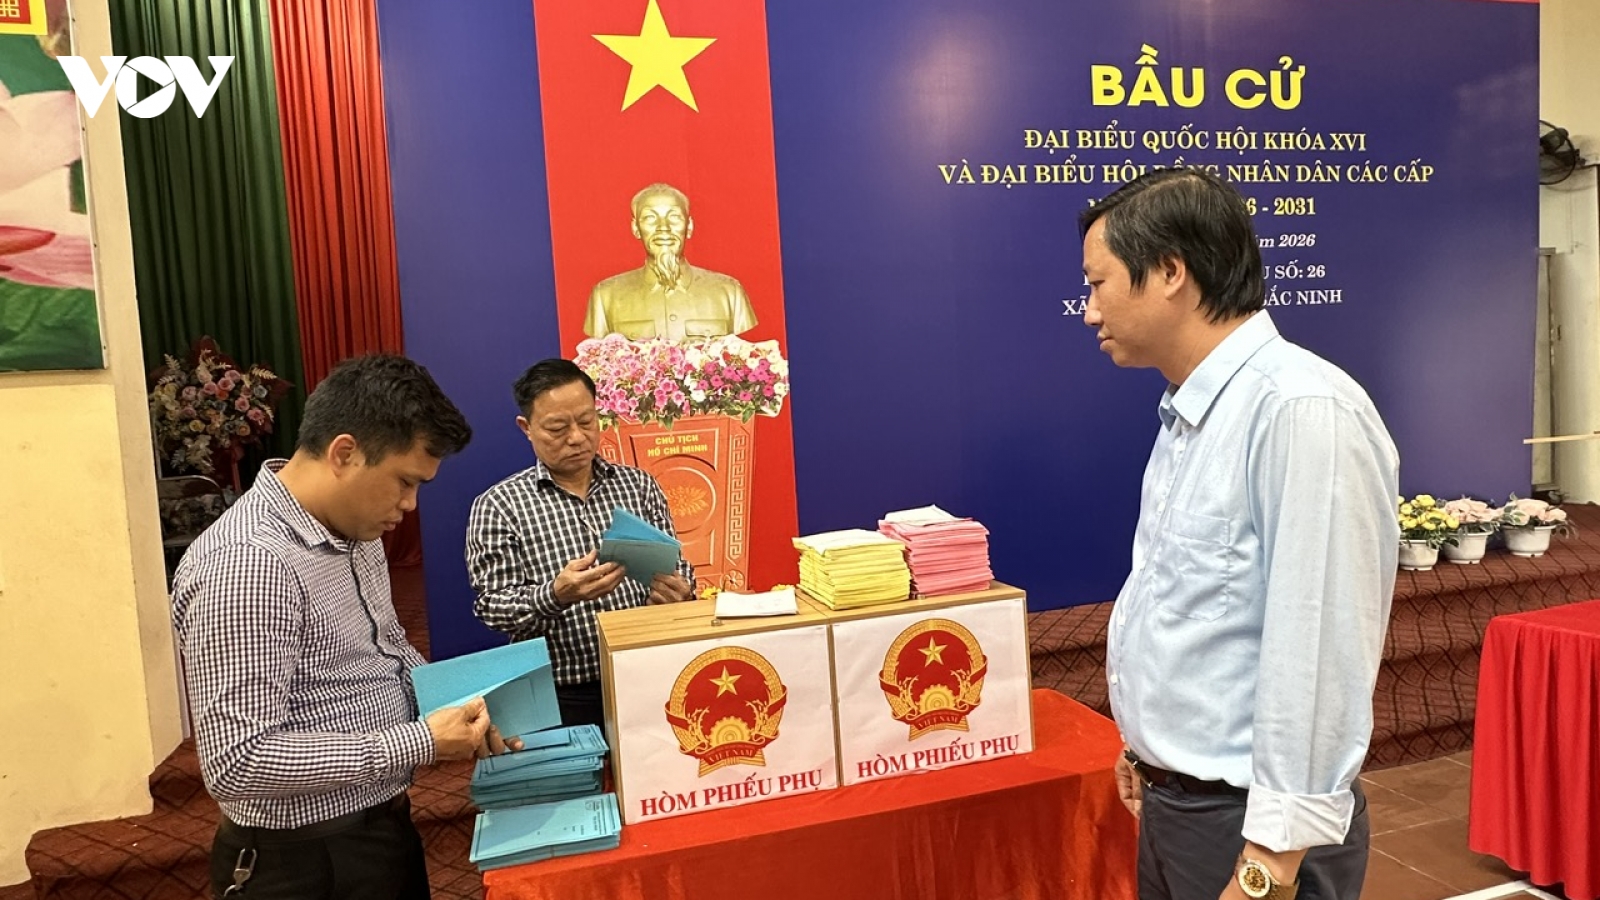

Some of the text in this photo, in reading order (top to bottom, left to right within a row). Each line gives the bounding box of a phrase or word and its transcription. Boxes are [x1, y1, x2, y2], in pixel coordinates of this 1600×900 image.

[1091, 43, 1306, 110] BẦU CỬ
[1024, 119, 1367, 155] ĐẠI BIỂU QUỐC HỘI KHÓA XVI
[938, 158, 975, 184] VÀ
[980, 164, 1027, 189] ĐẠI
[1034, 154, 1095, 184] BIỂU
[1226, 159, 1290, 183] NHÂN
[1296, 159, 1341, 183] DÂN
[1346, 159, 1388, 183] CÁC
[1393, 158, 1434, 183] CẤP
[1273, 197, 1316, 215] 2031
[1278, 234, 1316, 248] 2026
[1274, 259, 1304, 280] SỐ:
[1306, 264, 1326, 279] 26
[1296, 289, 1342, 305] NINH
[681, 444, 708, 454] MINH
[856, 734, 1020, 779] HÒM PHIẾU PHỤ
[640, 769, 822, 817] HÒM PHIẾU PHỤ
